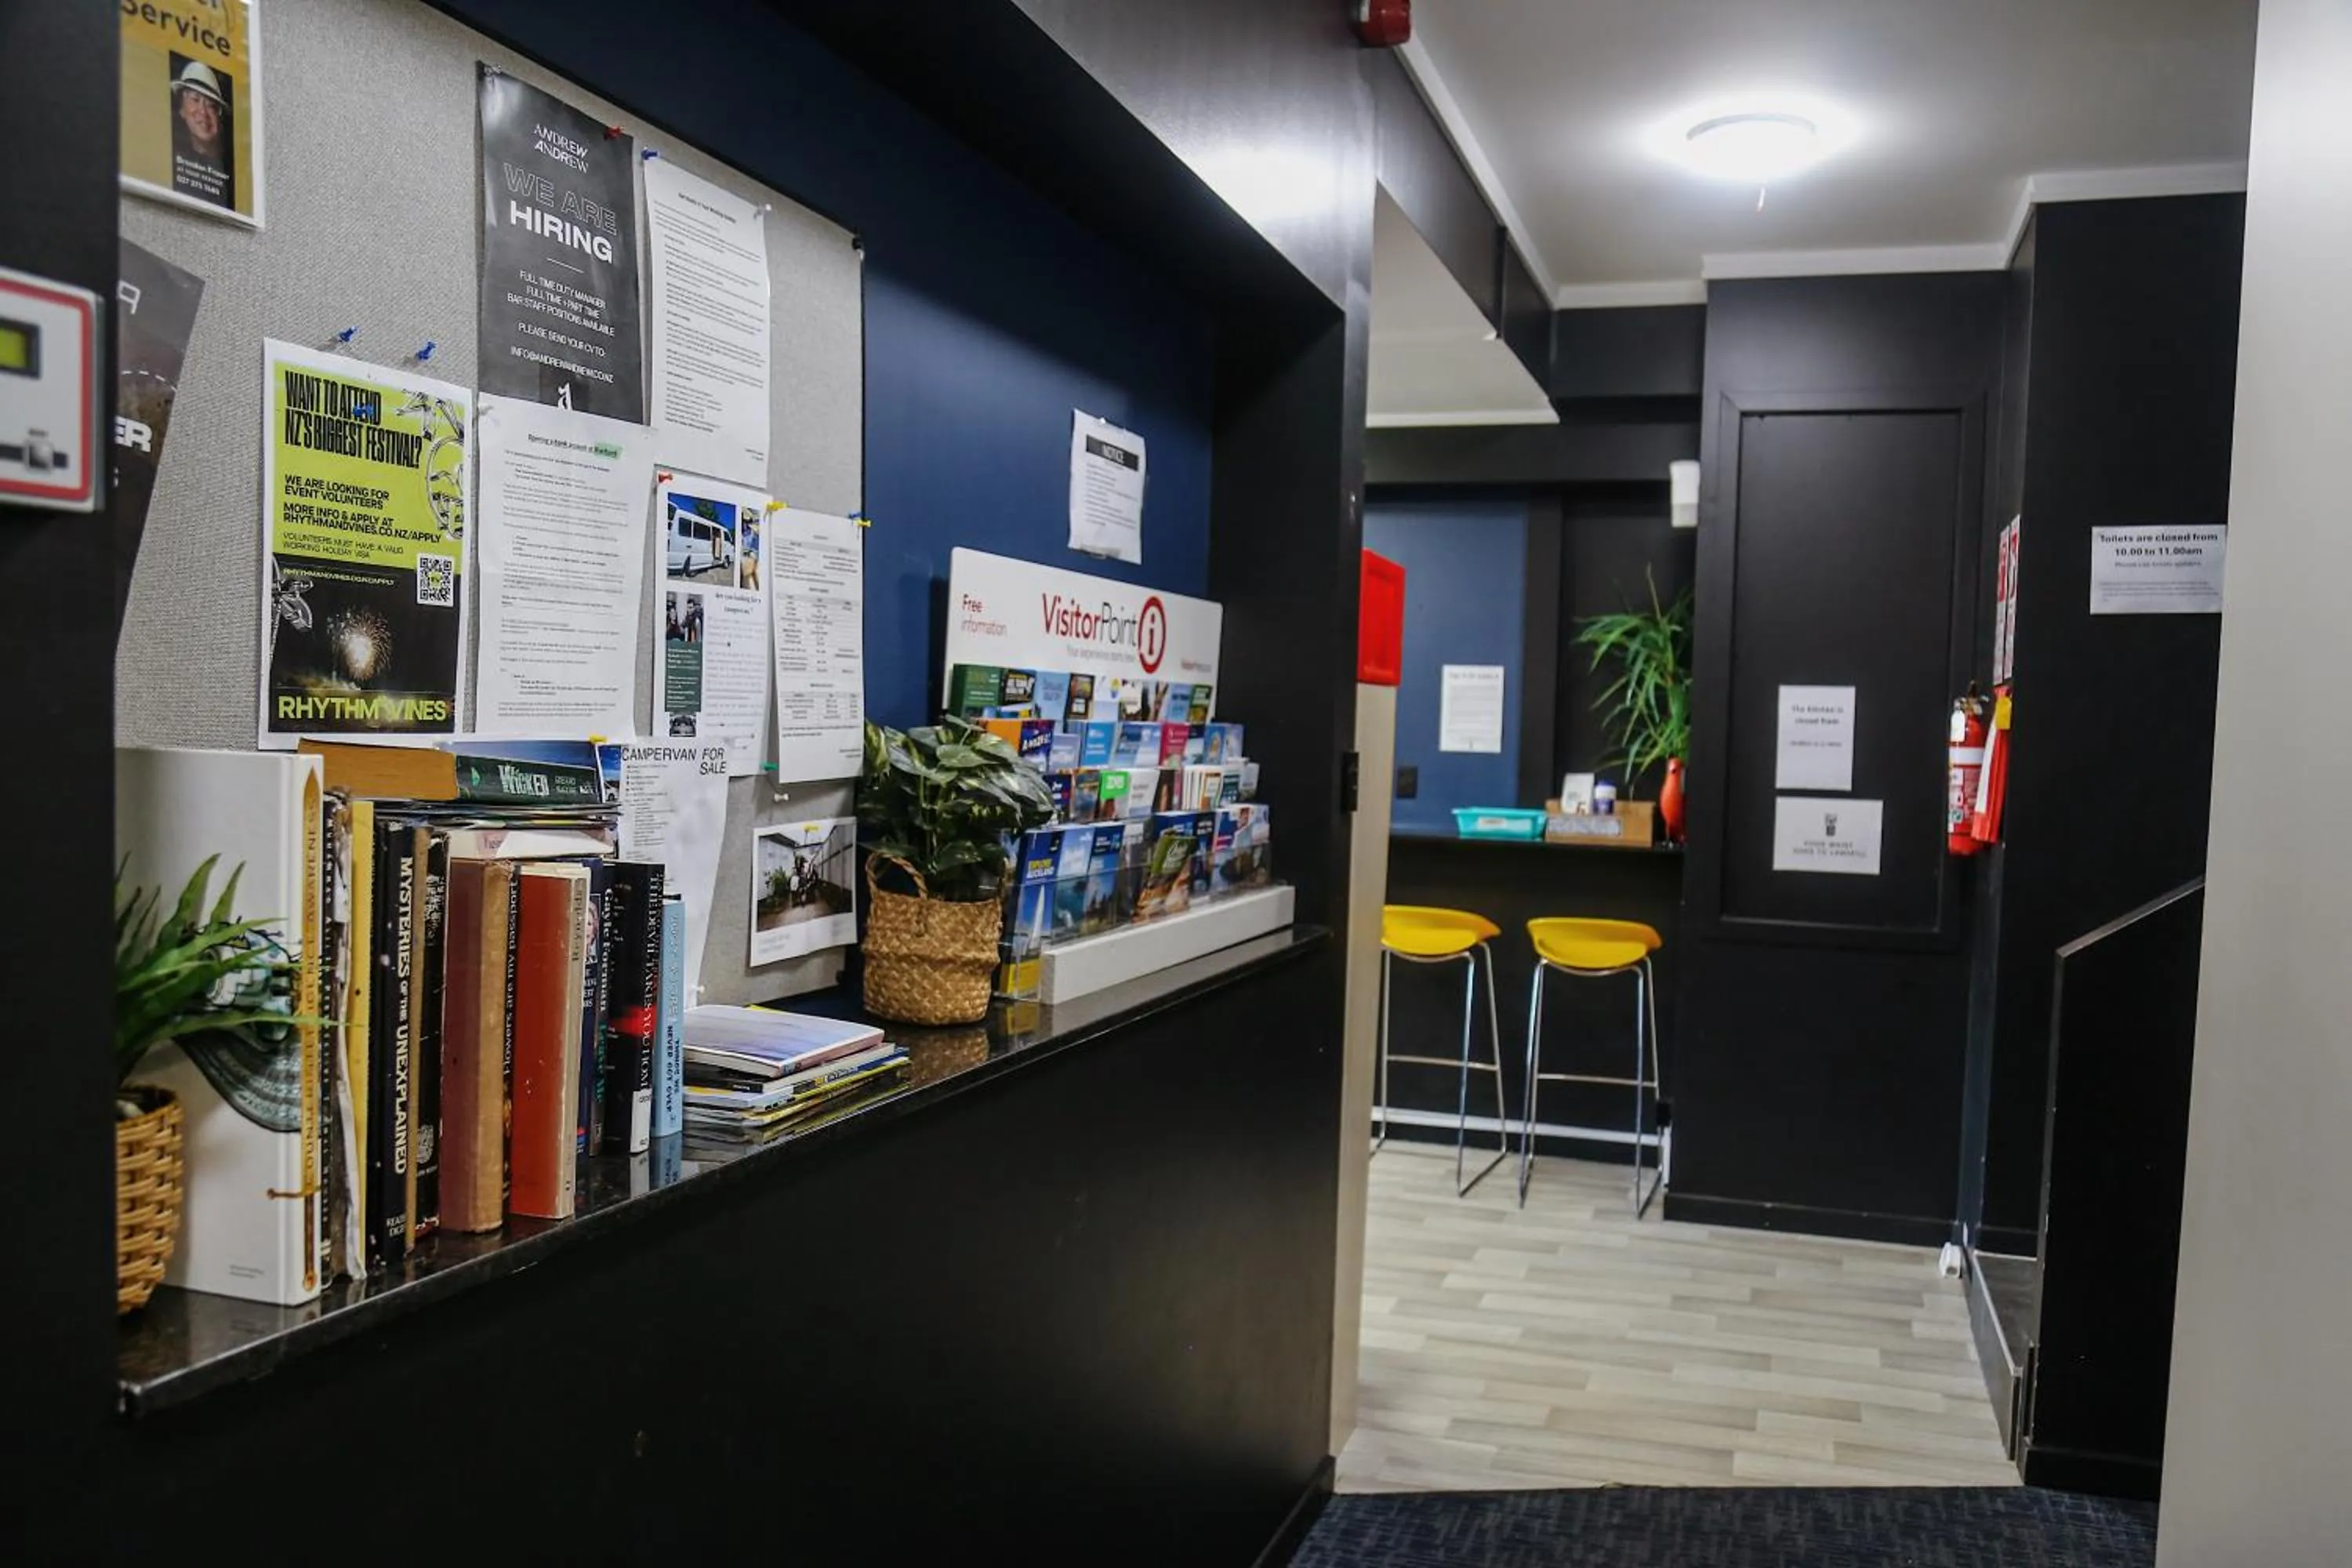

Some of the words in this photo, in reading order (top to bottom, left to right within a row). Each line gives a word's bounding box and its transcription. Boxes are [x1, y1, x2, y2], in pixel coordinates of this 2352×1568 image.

[534, 123, 588, 158] ANDREW
[534, 140, 589, 174] ANDREW
[503, 162, 554, 208] WE
[561, 191, 617, 236] ARE
[510, 200, 612, 264] HIRING
[520, 270, 538, 284] FULL
[539, 277, 556, 290] TIME
[557, 282, 574, 296] DUTY
[575, 290, 606, 309] MANAGER
[526, 285, 543, 299] FULL
[545, 292, 562, 305] TIME
[583, 305, 600, 319] TIME
[507, 292, 523, 304] BAR
[524, 297, 546, 312] STAFF
[547, 305, 582, 325] POSITIONS
[583, 319, 615, 337] AVAILABLE
[518, 322, 548, 339] PLEASE
[549, 329, 567, 344] SEND
[568, 336, 583, 350] YOUR
[285, 369, 321, 413] WANT
[323, 379, 339, 417] TO
[340, 383, 382, 426] ATTEND
[285, 407, 313, 449] NZ'S
[314, 415, 364, 459] BIGGEST
[365, 425, 423, 469] FESTIVAL?
[285, 474, 302, 486] WE
[304, 476, 325, 490] ARE
[326, 481, 369, 498] LOOKING
[371, 487, 390, 501] FOR
[285, 485, 320, 499] EVENT
[321, 490, 383, 510] VOLUNTEERS
[283, 501, 314, 515] MORE
[316, 506, 339, 519] INFO
[341, 510, 349, 521] &
[350, 511, 380, 524] APPLY
[382, 517, 394, 528] AT
[283, 512, 442, 543] RHYTHMANDVINES.CO.NZ/APPLY
[283, 532, 332, 546] VOLUNTEERS
[334, 539, 354, 547] MUST
[355, 542, 375, 550] HAVE
[283, 541, 321, 553] WORKING
[322, 546, 353, 557] HOLIDAY
[355, 550, 371, 559] VISA
[2100, 533, 2134, 543] Toilets
[2155, 532, 2190, 543] closed
[2192, 532, 2219, 542] from
[960, 615, 1008, 639] information
[963, 593, 982, 613] Free
[1042, 592, 1138, 647] VisitorPoint
[278, 695, 379, 720] RHYTHM
[390, 699, 446, 721] VINES
[621, 746, 698, 763] CAMPERVAN
[702, 747, 725, 760] FOR
[699, 761, 727, 775] SALE
[397, 856, 413, 978] MYSTERIES
[508, 879, 517, 950] passport
[601, 887, 614, 938] Gayle
[599, 941, 612, 1012] Forman
[644, 958, 655, 1011] TAKES
[642, 1011, 653, 1047] YOU
[394, 1023, 409, 1174] UNEXPLAINED
